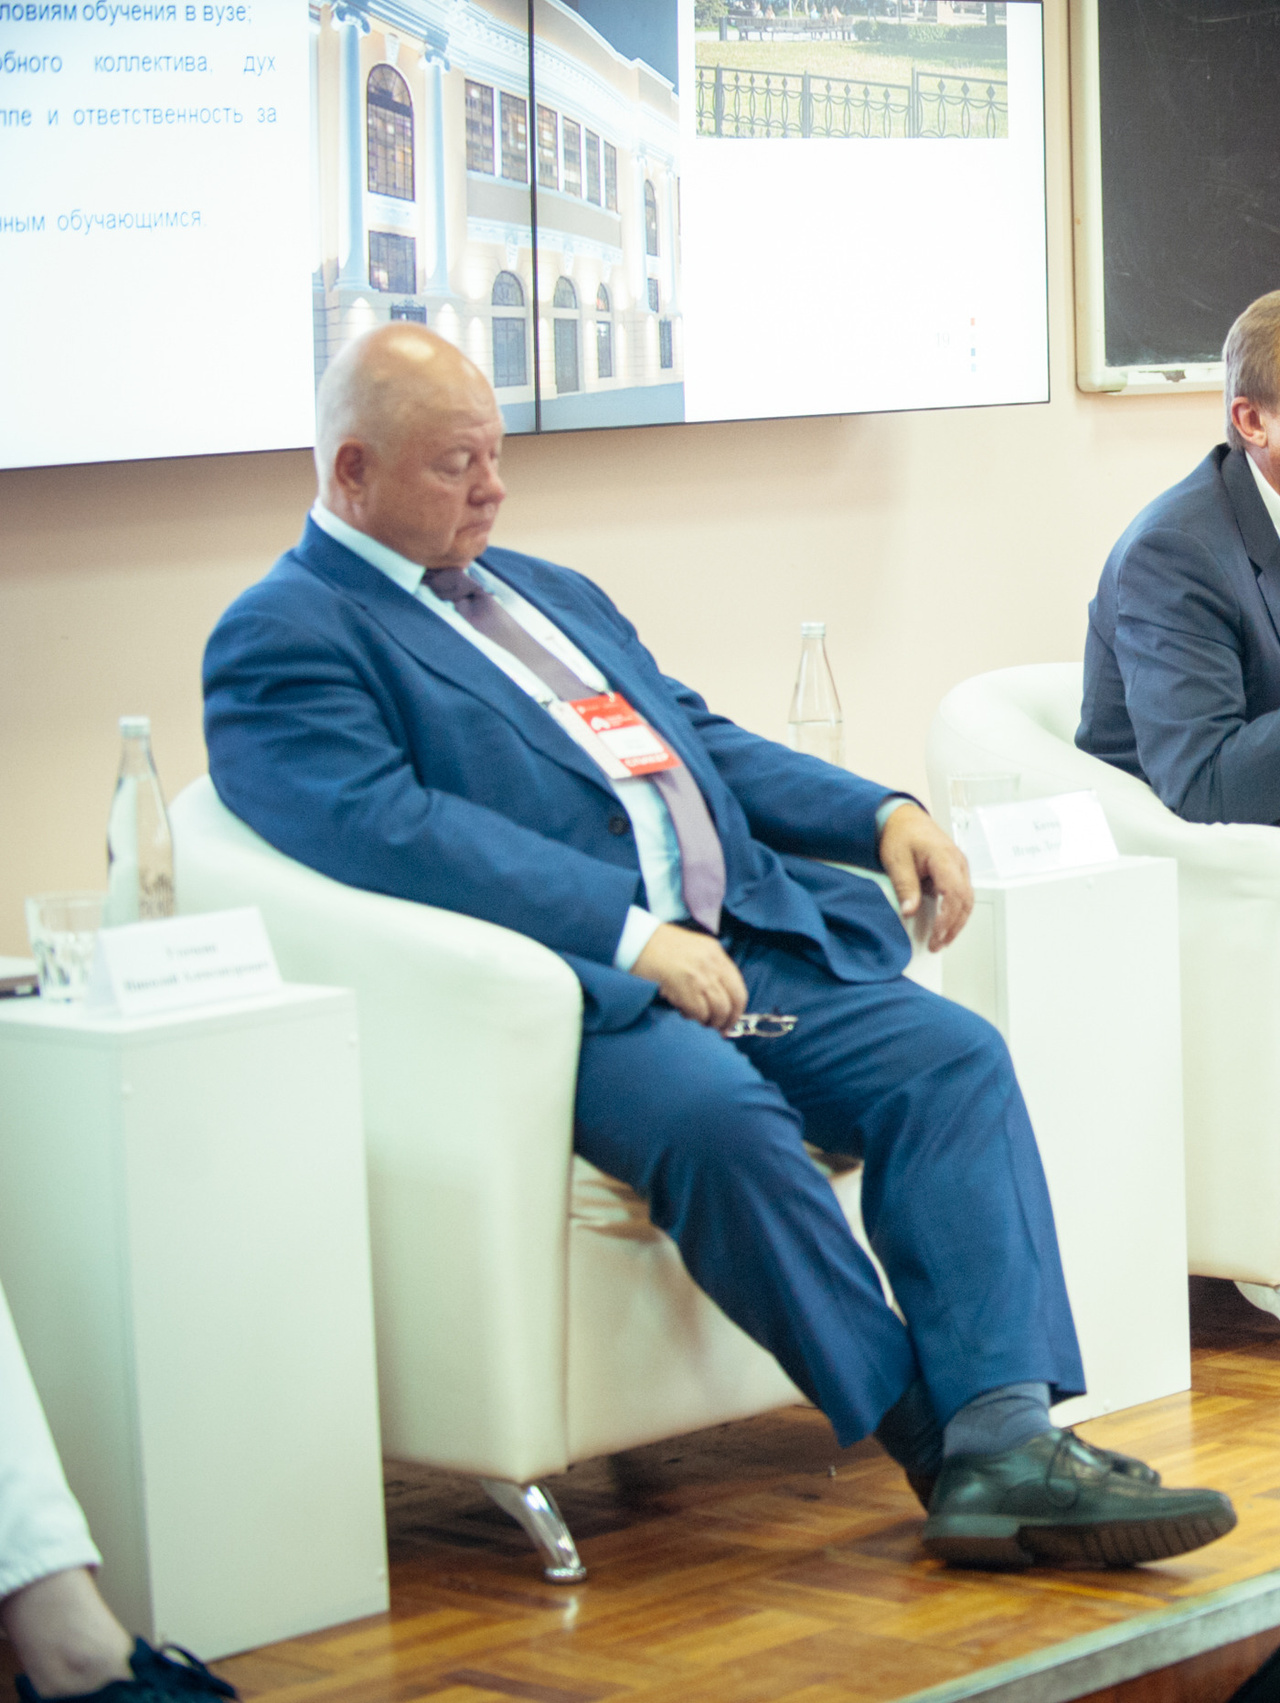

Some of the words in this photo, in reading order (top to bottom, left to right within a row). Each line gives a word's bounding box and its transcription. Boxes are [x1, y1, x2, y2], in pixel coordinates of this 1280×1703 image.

[82, 0, 177, 26] обучения
[185, 4, 197, 21] в
[203, 4, 251, 26] вузе;
[0, 50, 63, 74] бного
[243, 54, 276, 76] дух
[48, 108, 59, 126] и
[73, 106, 243, 126] ответственность
[257, 106, 277, 123] за
[0, 215, 46, 233] ным
